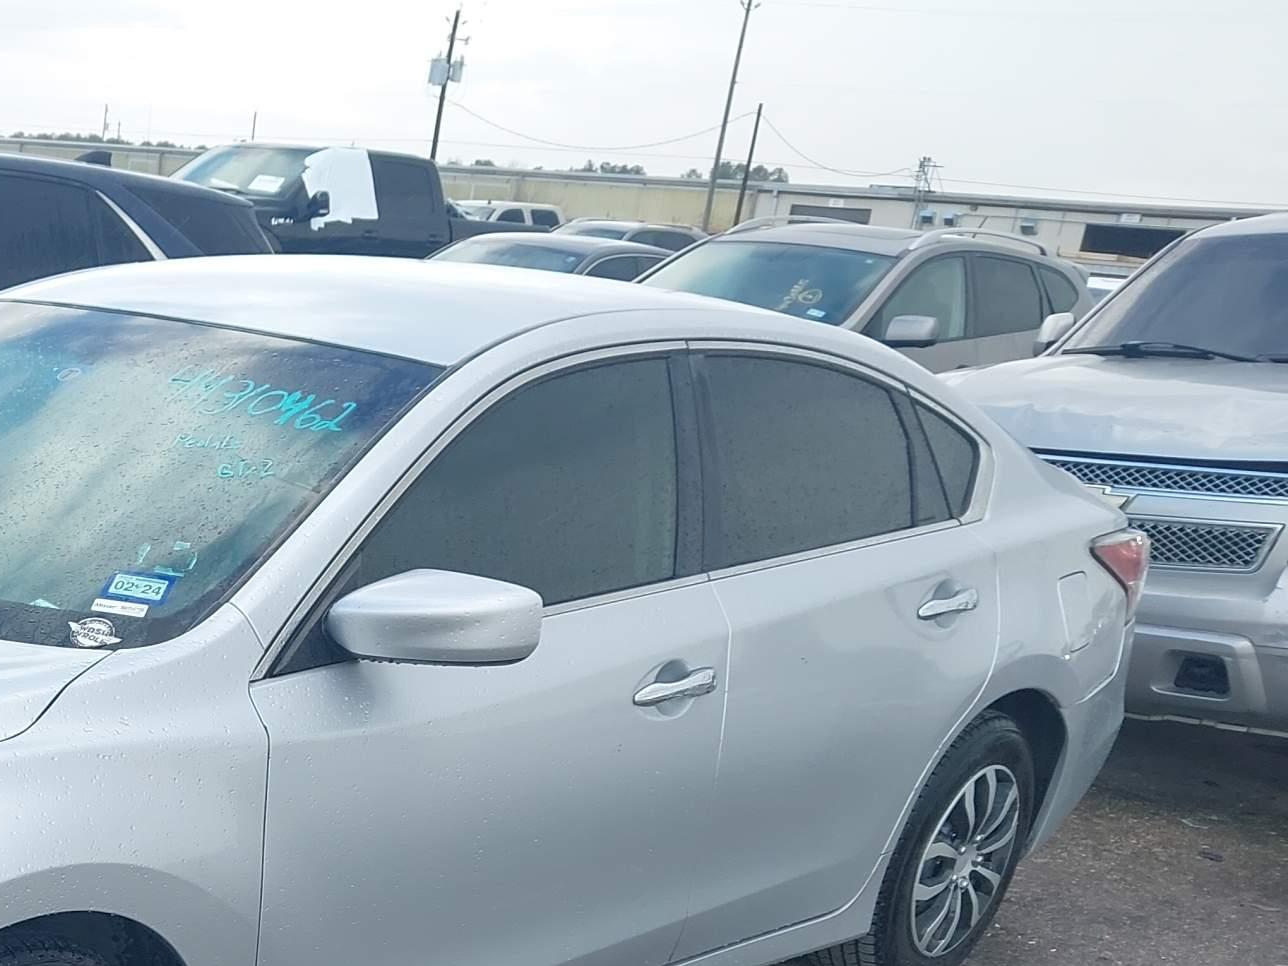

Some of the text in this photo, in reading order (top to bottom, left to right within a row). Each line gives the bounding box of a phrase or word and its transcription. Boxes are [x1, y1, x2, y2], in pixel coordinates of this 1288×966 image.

[167, 366, 357, 431] 44310462
[114, 580, 162, 596] 02 24
